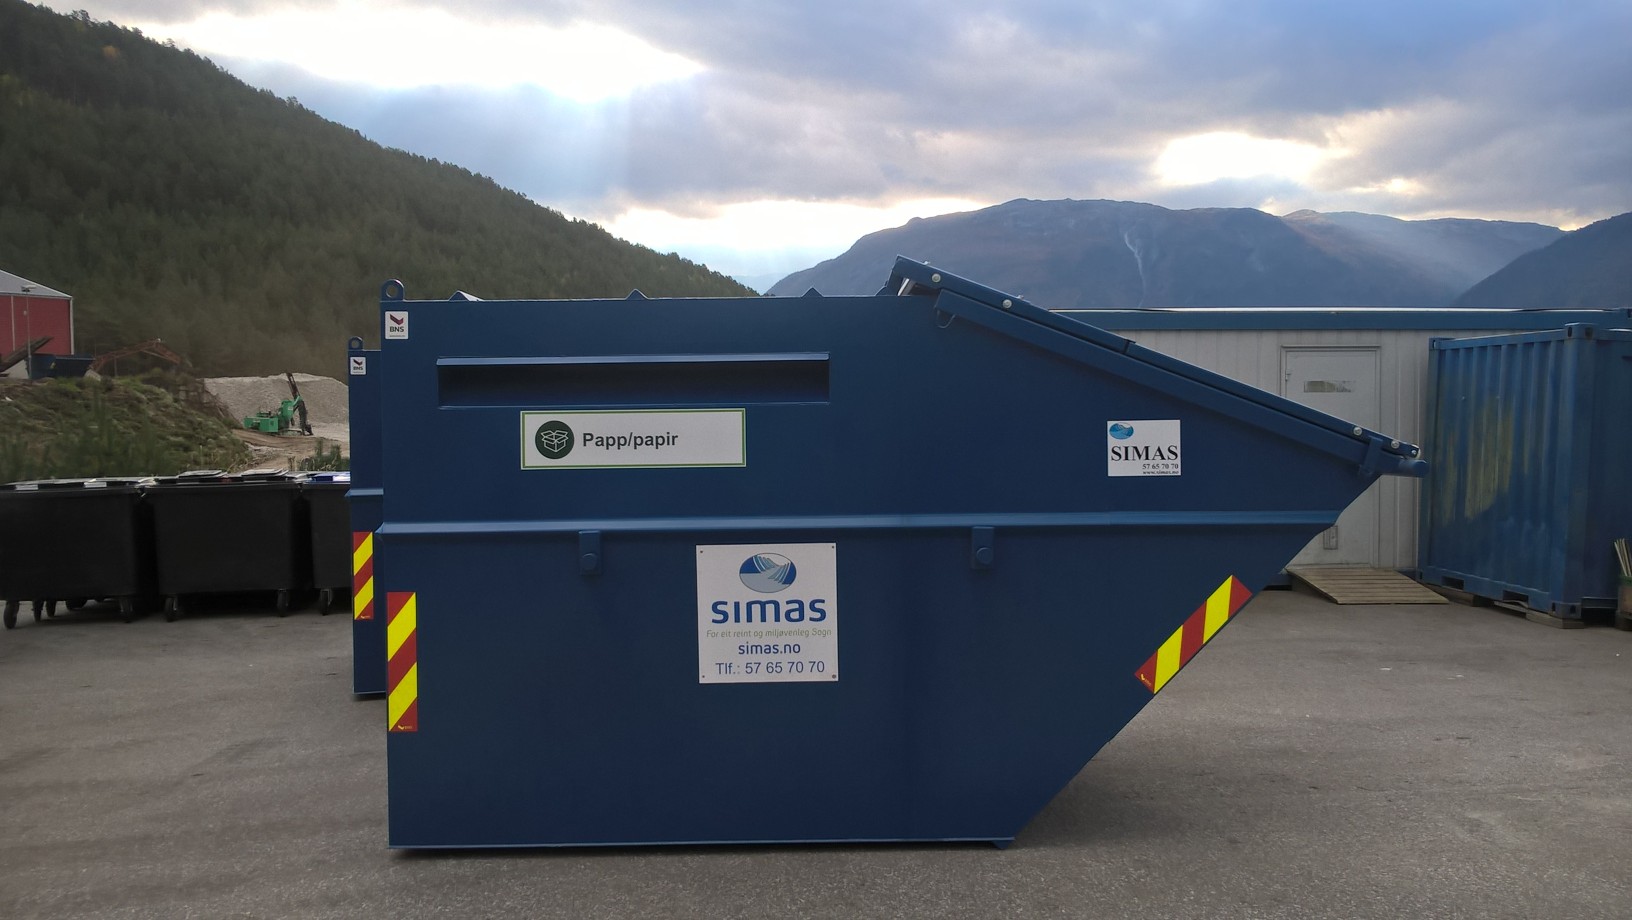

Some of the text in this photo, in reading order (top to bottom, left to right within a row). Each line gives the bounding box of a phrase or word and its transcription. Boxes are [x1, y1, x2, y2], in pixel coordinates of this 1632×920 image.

[582, 431, 678, 450] Papp/papir
[1111, 445, 1178, 461] SIMAS
[711, 599, 827, 624] simas
[706, 630, 719, 638] For
[721, 630, 732, 638] eit
[754, 631, 763, 639] og
[738, 642, 801, 655] simas.no
[715, 661, 825, 675] Tlf.: 57 65 70 70
